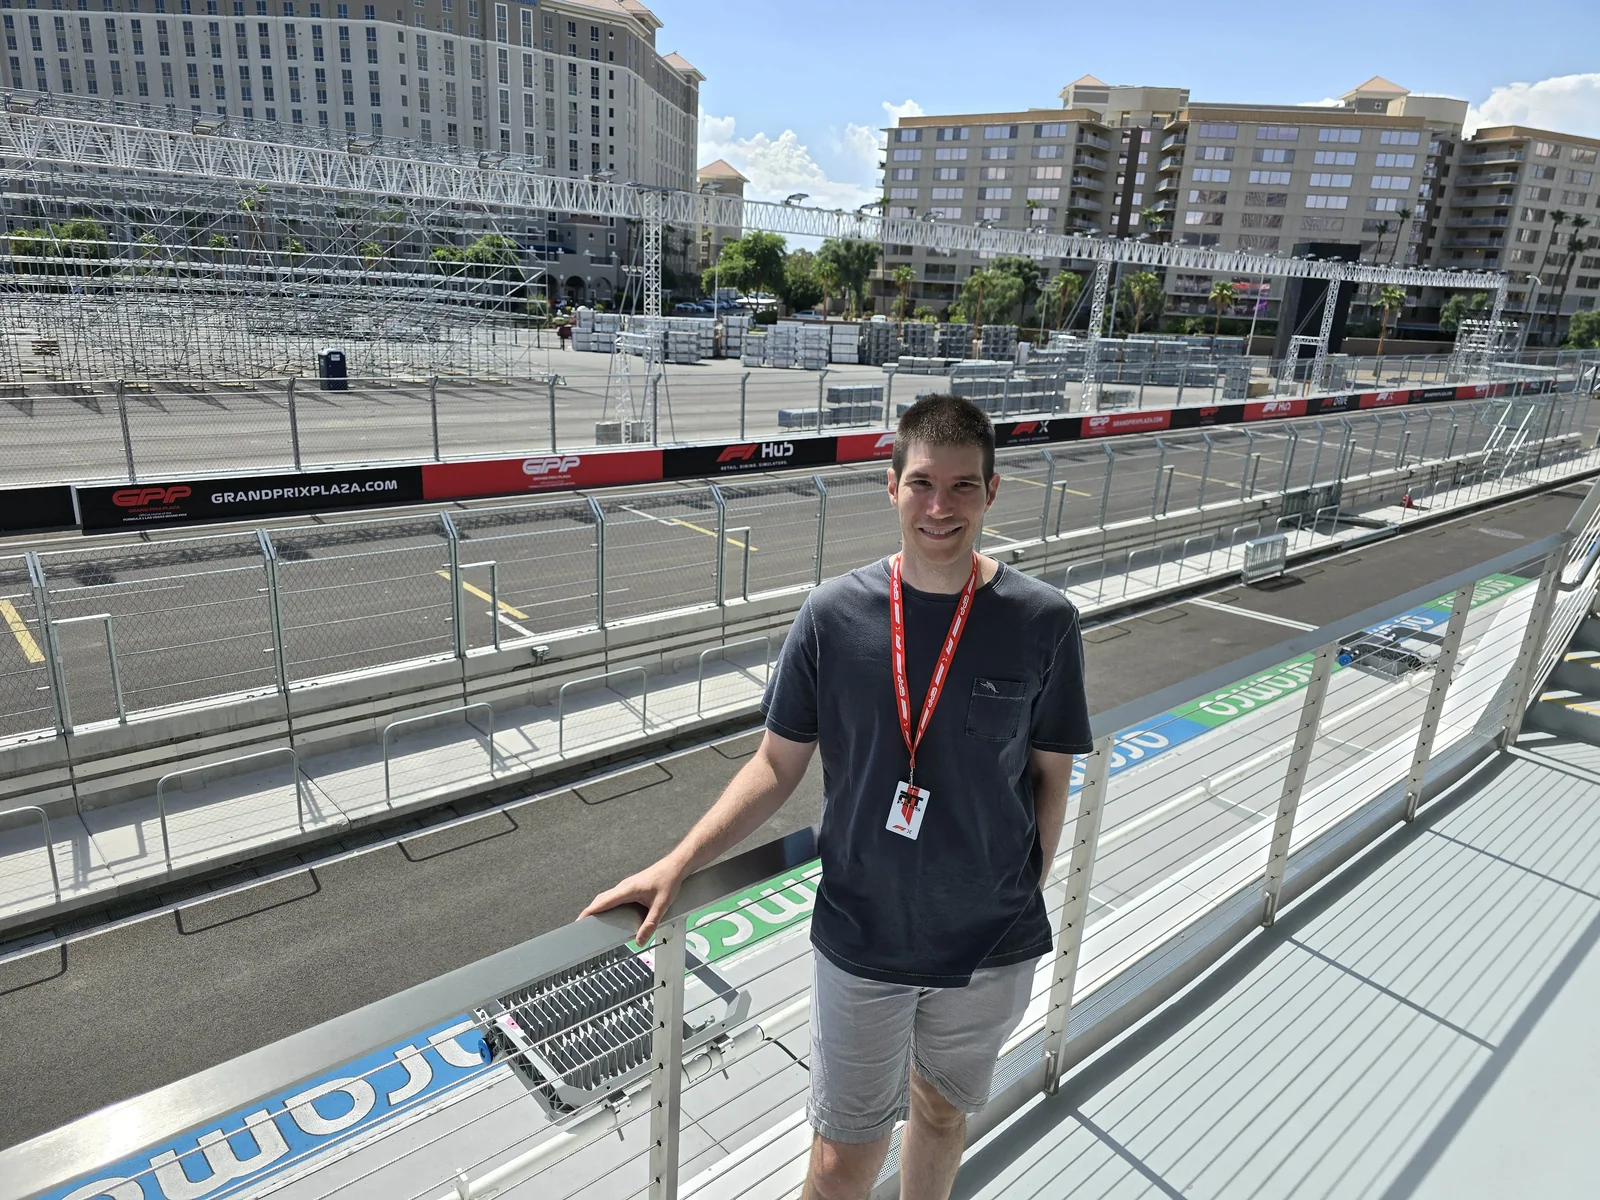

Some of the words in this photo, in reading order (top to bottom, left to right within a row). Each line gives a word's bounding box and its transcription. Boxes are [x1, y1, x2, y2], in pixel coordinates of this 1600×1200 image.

[522, 456, 581, 475] GPP
[112, 485, 192, 507] GPP
[211, 479, 398, 504] GRANDPRIXPLAZA.COM
